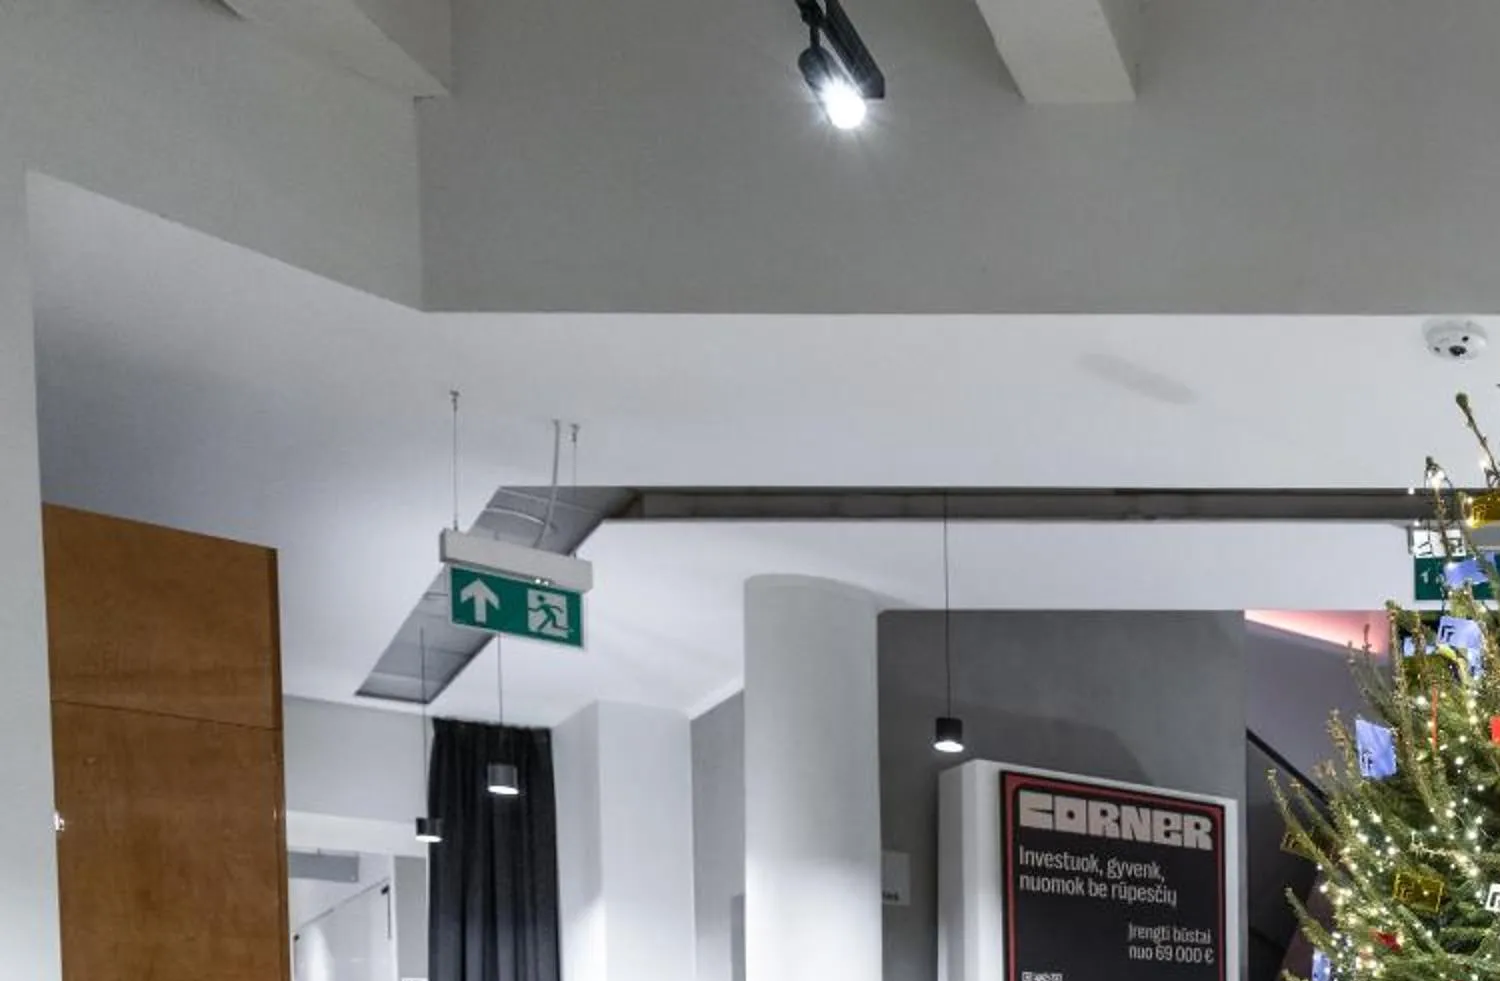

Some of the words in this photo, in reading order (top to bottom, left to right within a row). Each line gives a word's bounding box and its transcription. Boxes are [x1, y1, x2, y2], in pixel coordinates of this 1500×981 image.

[1019, 789, 1213, 850] CORNER
[1019, 845, 1103, 876] Investuok,
[1107, 856, 1165, 883] gyvenk,
[1019, 874, 1085, 896] nuomok
[1088, 877, 1107, 898] be
[1111, 881, 1177, 907] rūpesčių
[1129, 944, 1153, 960] nuo
[1203, 946, 1214, 964] €
